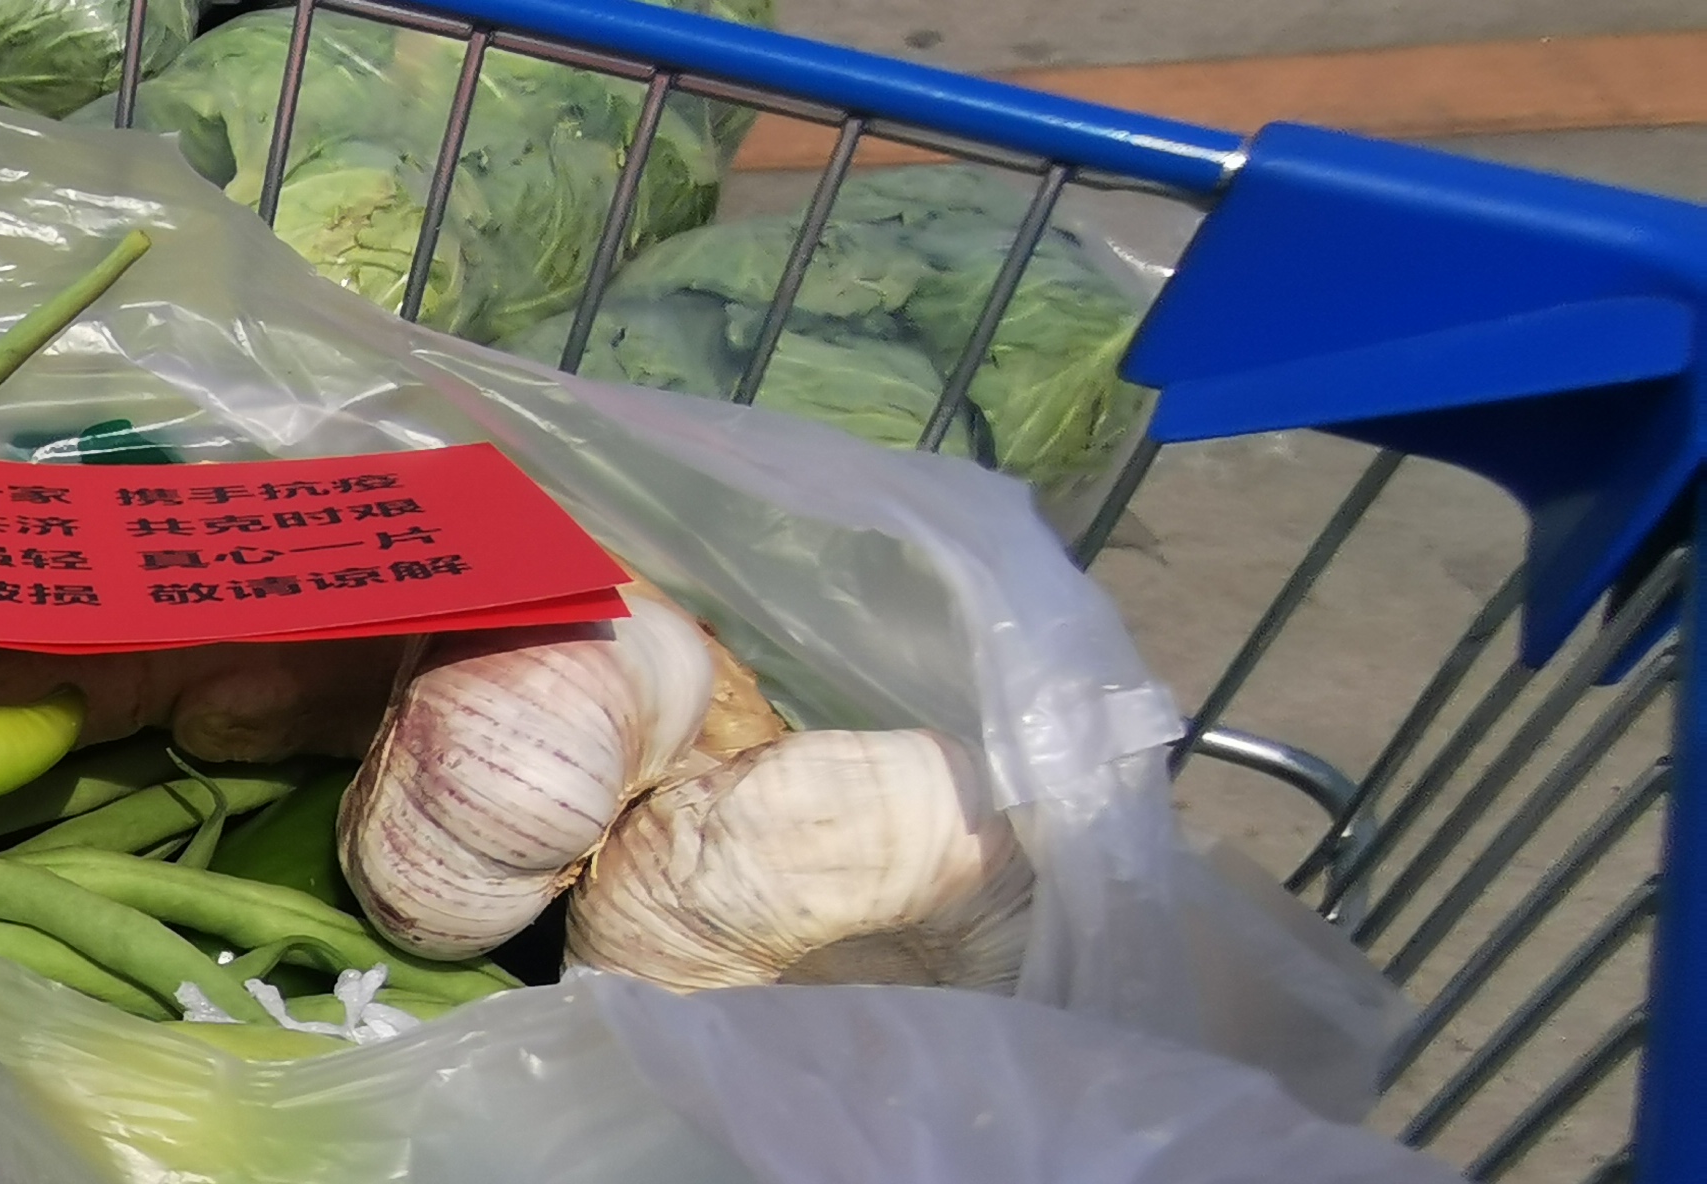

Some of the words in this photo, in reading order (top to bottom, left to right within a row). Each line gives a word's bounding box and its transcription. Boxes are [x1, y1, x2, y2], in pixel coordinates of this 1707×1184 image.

[116, 472, 403, 507] 携手抗疫
[129, 499, 423, 537] 共克时艰
[143, 525, 443, 570] 真心一片
[150, 555, 470, 604] 敬请谅解
